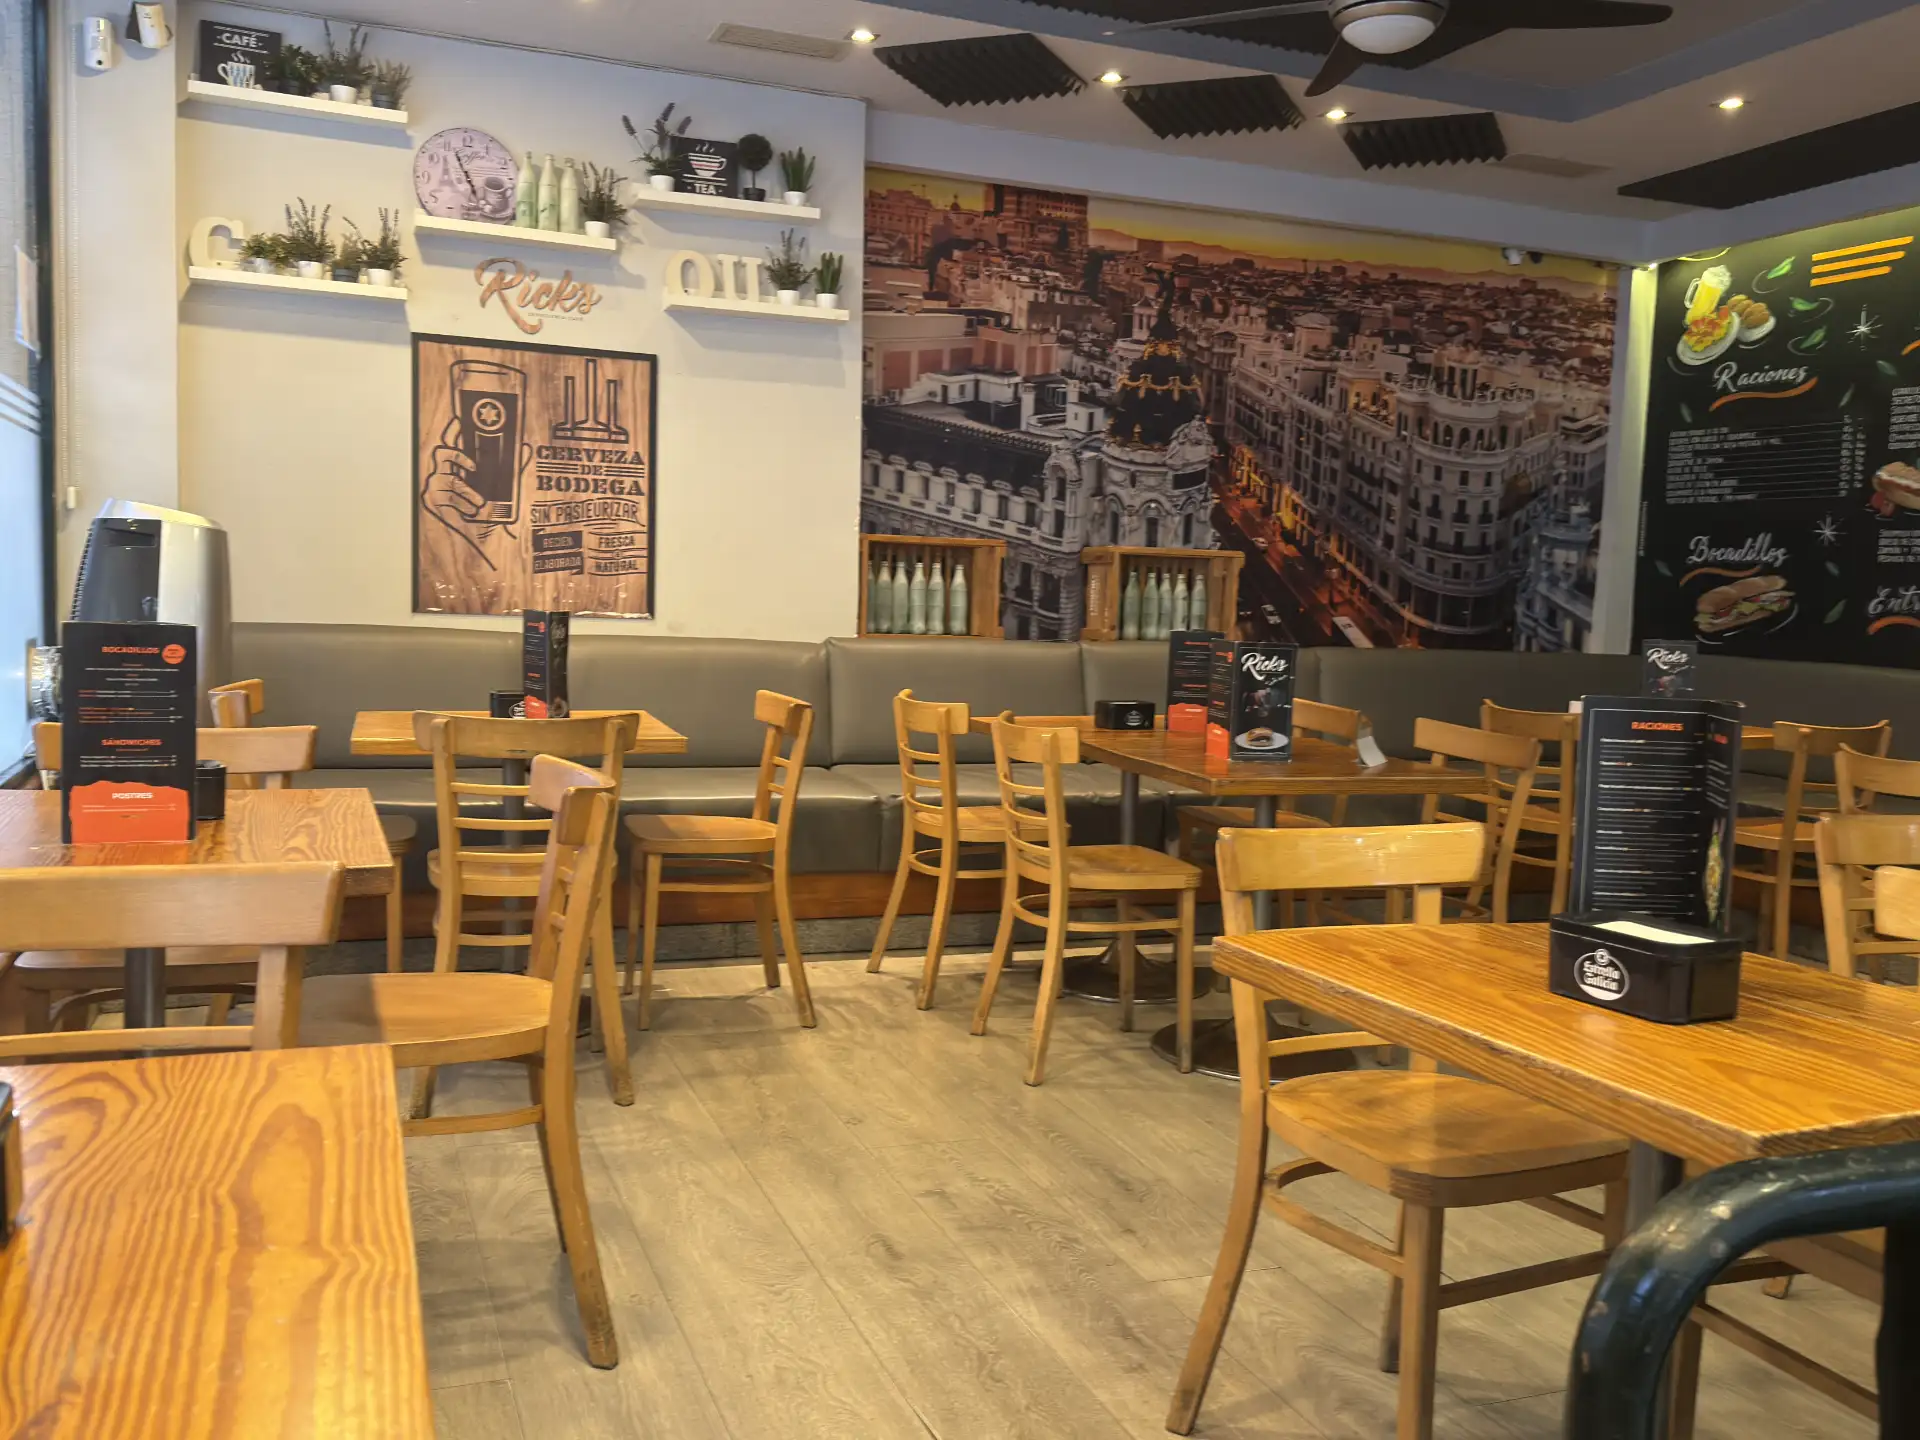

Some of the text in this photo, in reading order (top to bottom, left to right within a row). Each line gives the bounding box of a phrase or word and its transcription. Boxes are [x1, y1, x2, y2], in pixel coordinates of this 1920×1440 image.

[221, 32, 258, 49] CAFÉ
[693, 183, 717, 195] TEA
[1712, 361, 1808, 392] Raciones
[536, 445, 645, 466] CERVEZA
[581, 464, 603, 476] DE
[536, 475, 645, 496] BODEGA
[530, 501, 638, 524] SIN PASTEURIZAR
[599, 535, 635, 549] FRESCA
[1686, 533, 1788, 568] Bocadillos
[1631, 721, 1684, 731] RACIONES
